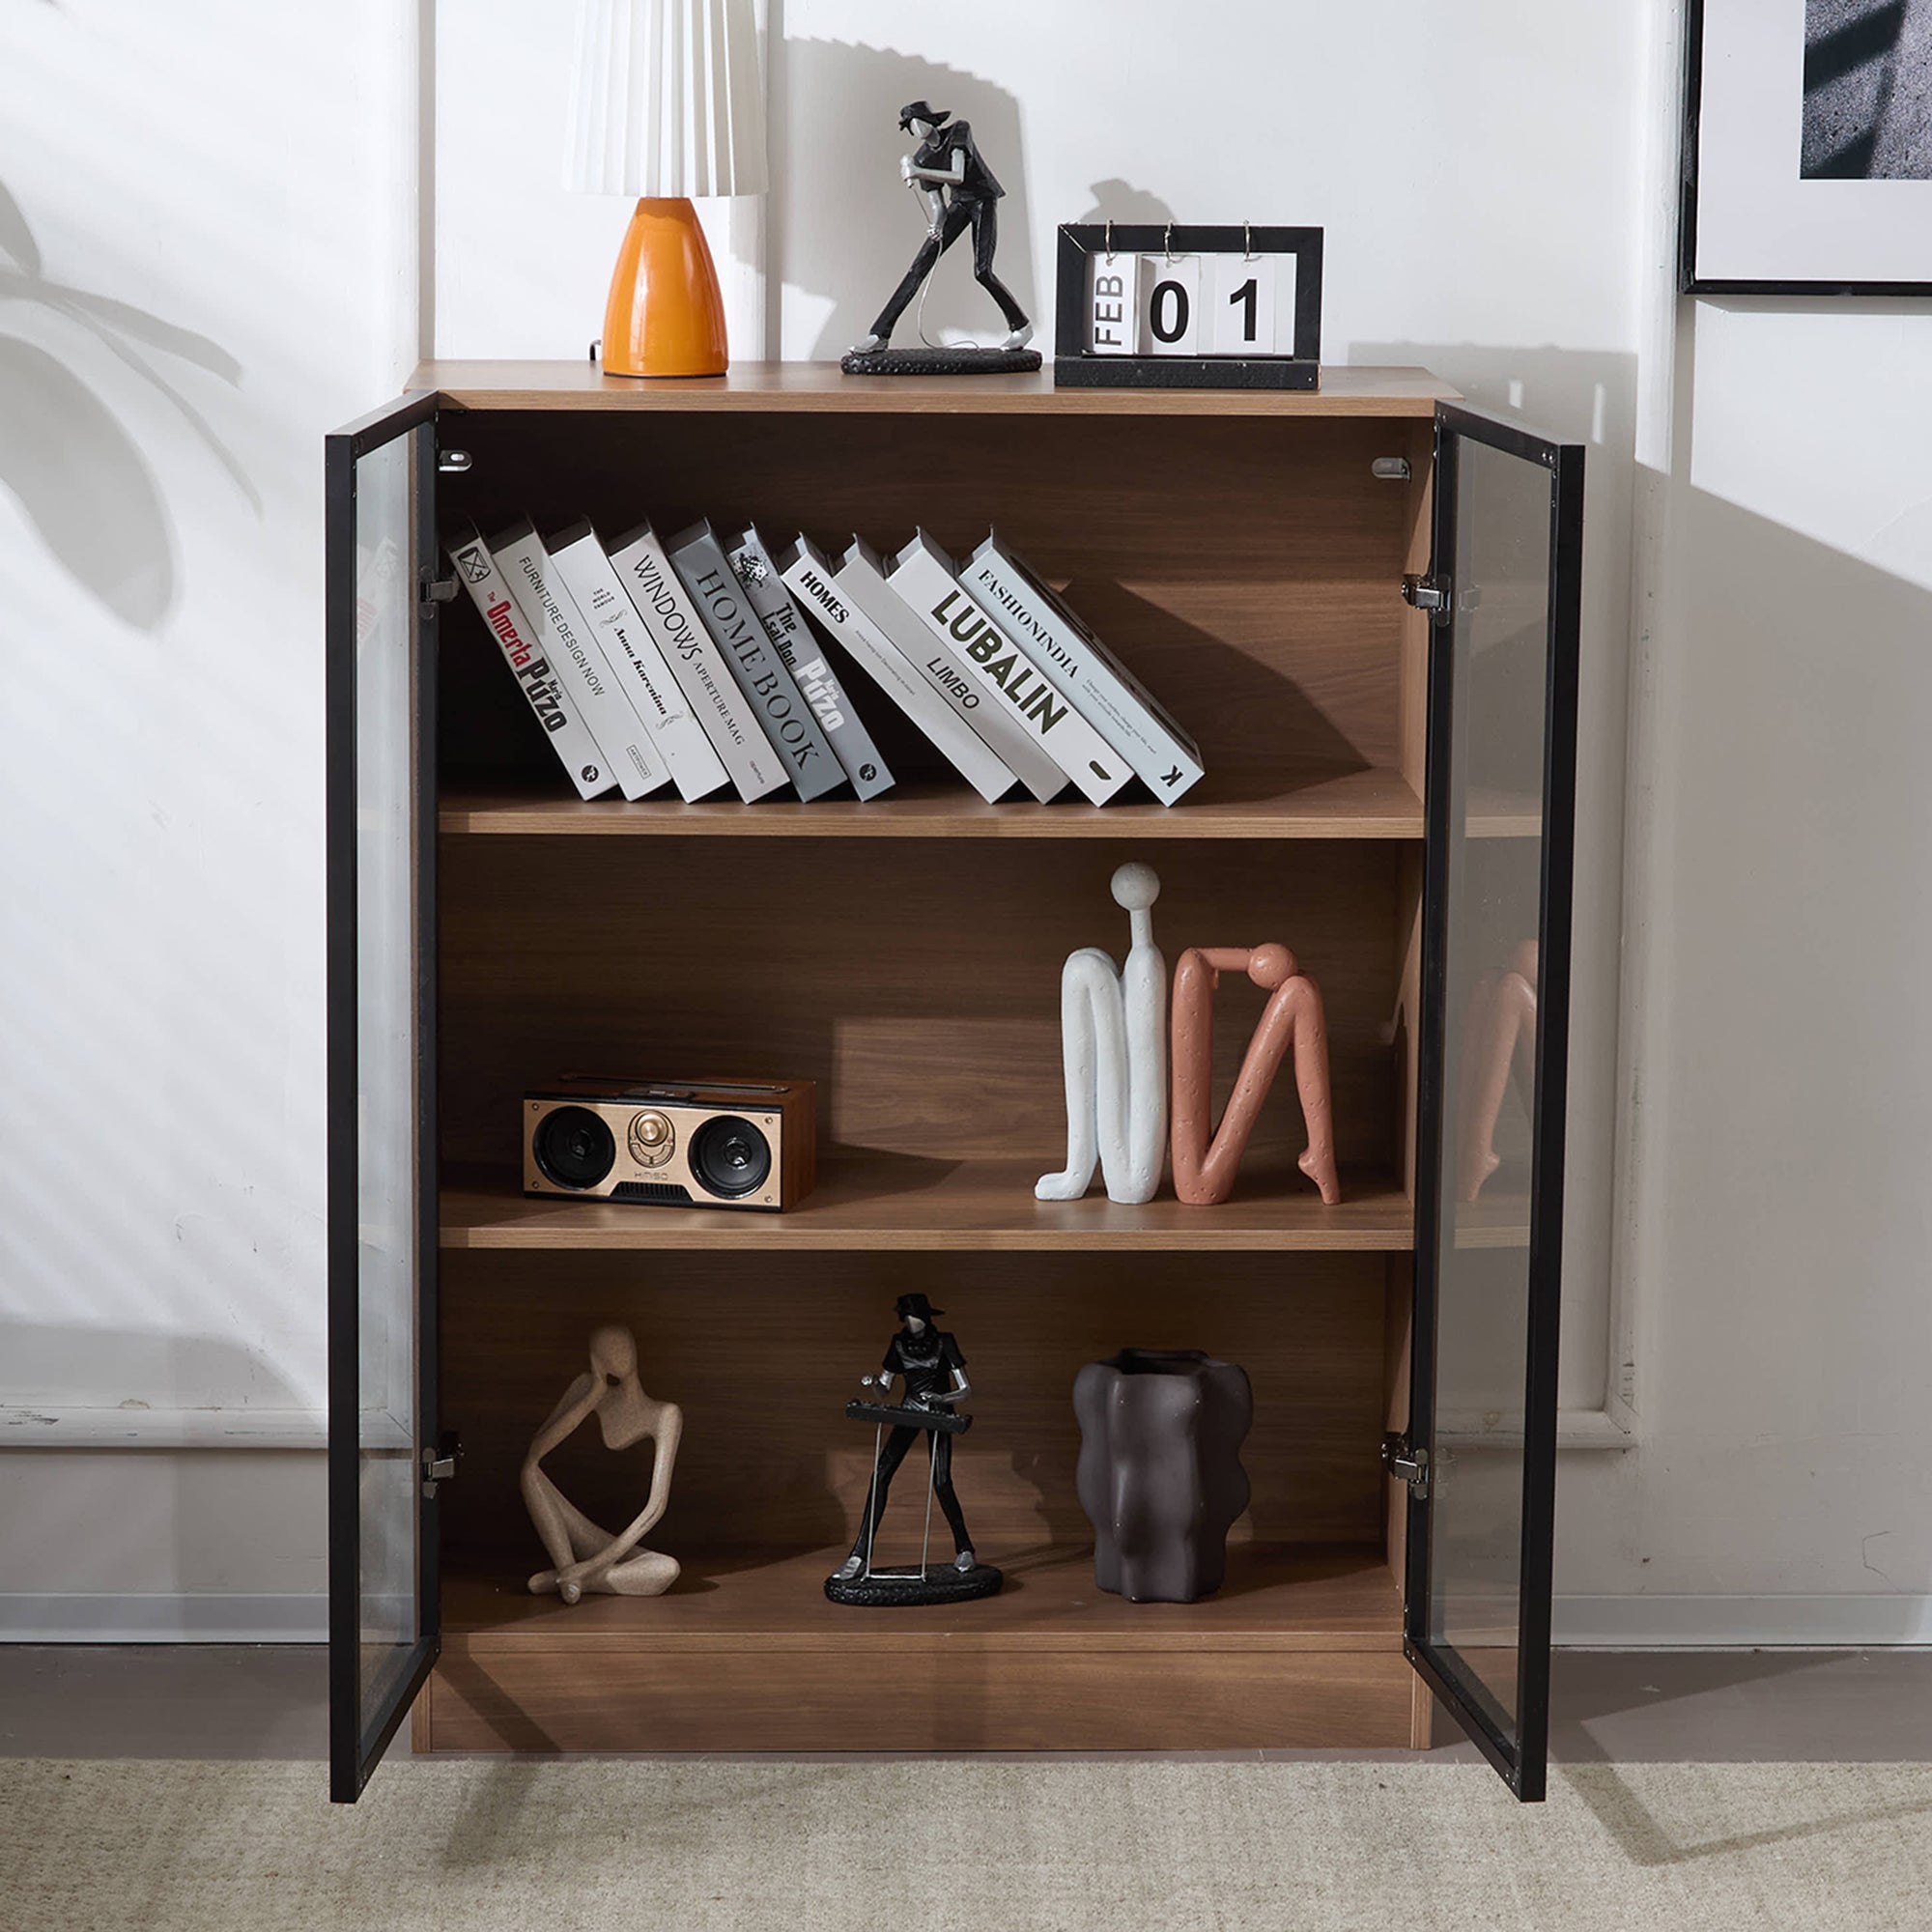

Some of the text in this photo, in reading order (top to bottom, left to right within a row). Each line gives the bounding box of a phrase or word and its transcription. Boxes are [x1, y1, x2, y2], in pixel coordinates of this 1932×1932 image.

[1095, 275, 1122, 346] FEB
[487, 600, 533, 667] Omerta
[519, 556, 606, 696] FURNITURE DESIGN NOW
[634, 554, 702, 660] WINDOWS
[775, 602, 797, 634] The
[800, 570, 850, 624] HOMES
[978, 569, 1079, 678] FASHIONINDIA
[614, 628, 668, 715] Anna Karenina
[696, 569, 819, 770] HOME BOOK
[778, 639, 798, 667] Don
[926, 657, 980, 709] LIMBO
[930, 589, 1068, 734] LUBALIN
[694, 662, 746, 745] APERTURE MAG
